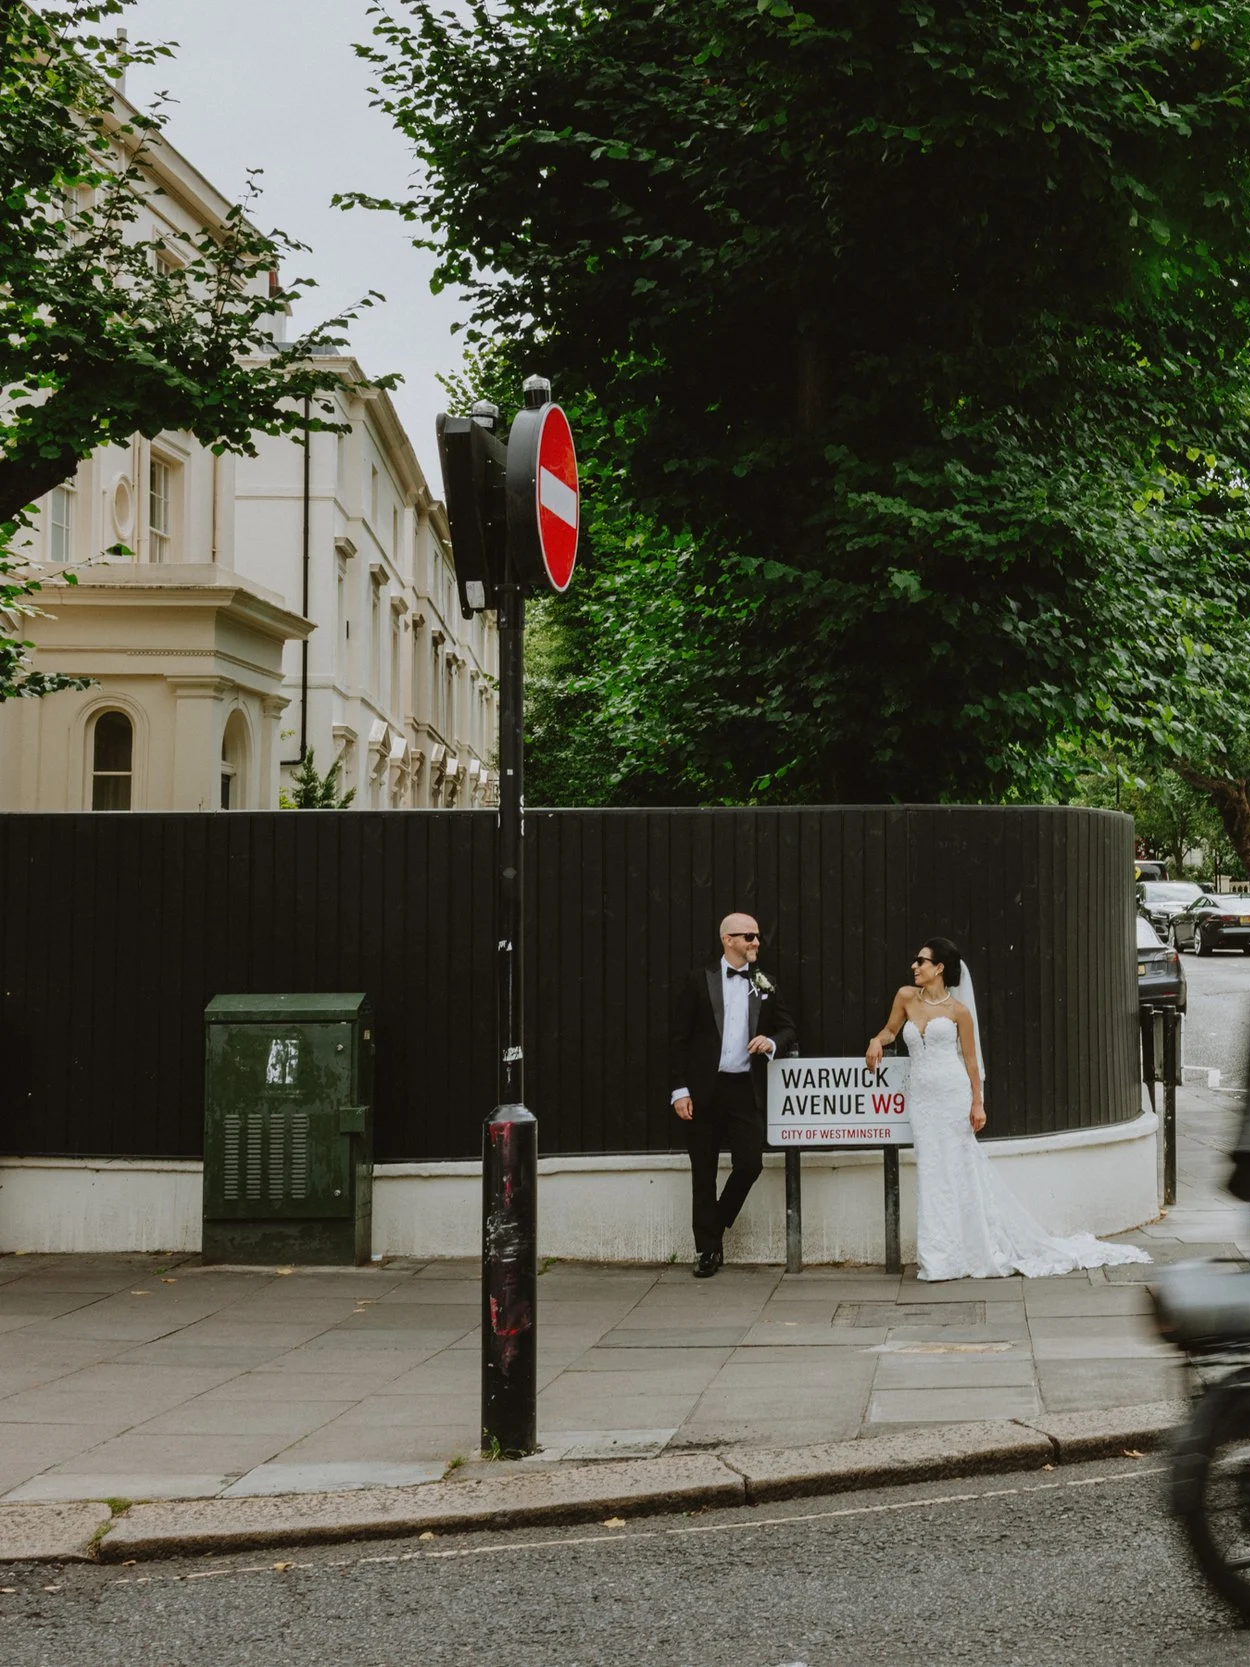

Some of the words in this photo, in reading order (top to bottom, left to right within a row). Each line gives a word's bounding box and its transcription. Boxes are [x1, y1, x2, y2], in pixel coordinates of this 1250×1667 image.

[781, 1067, 889, 1089] WARWICK
[781, 1094, 866, 1116] AVENUE
[871, 1092, 905, 1115] W9
[781, 1129, 803, 1140] CITY
[805, 1129, 818, 1140] OF
[820, 1128, 891, 1139] WESTMINSTER
